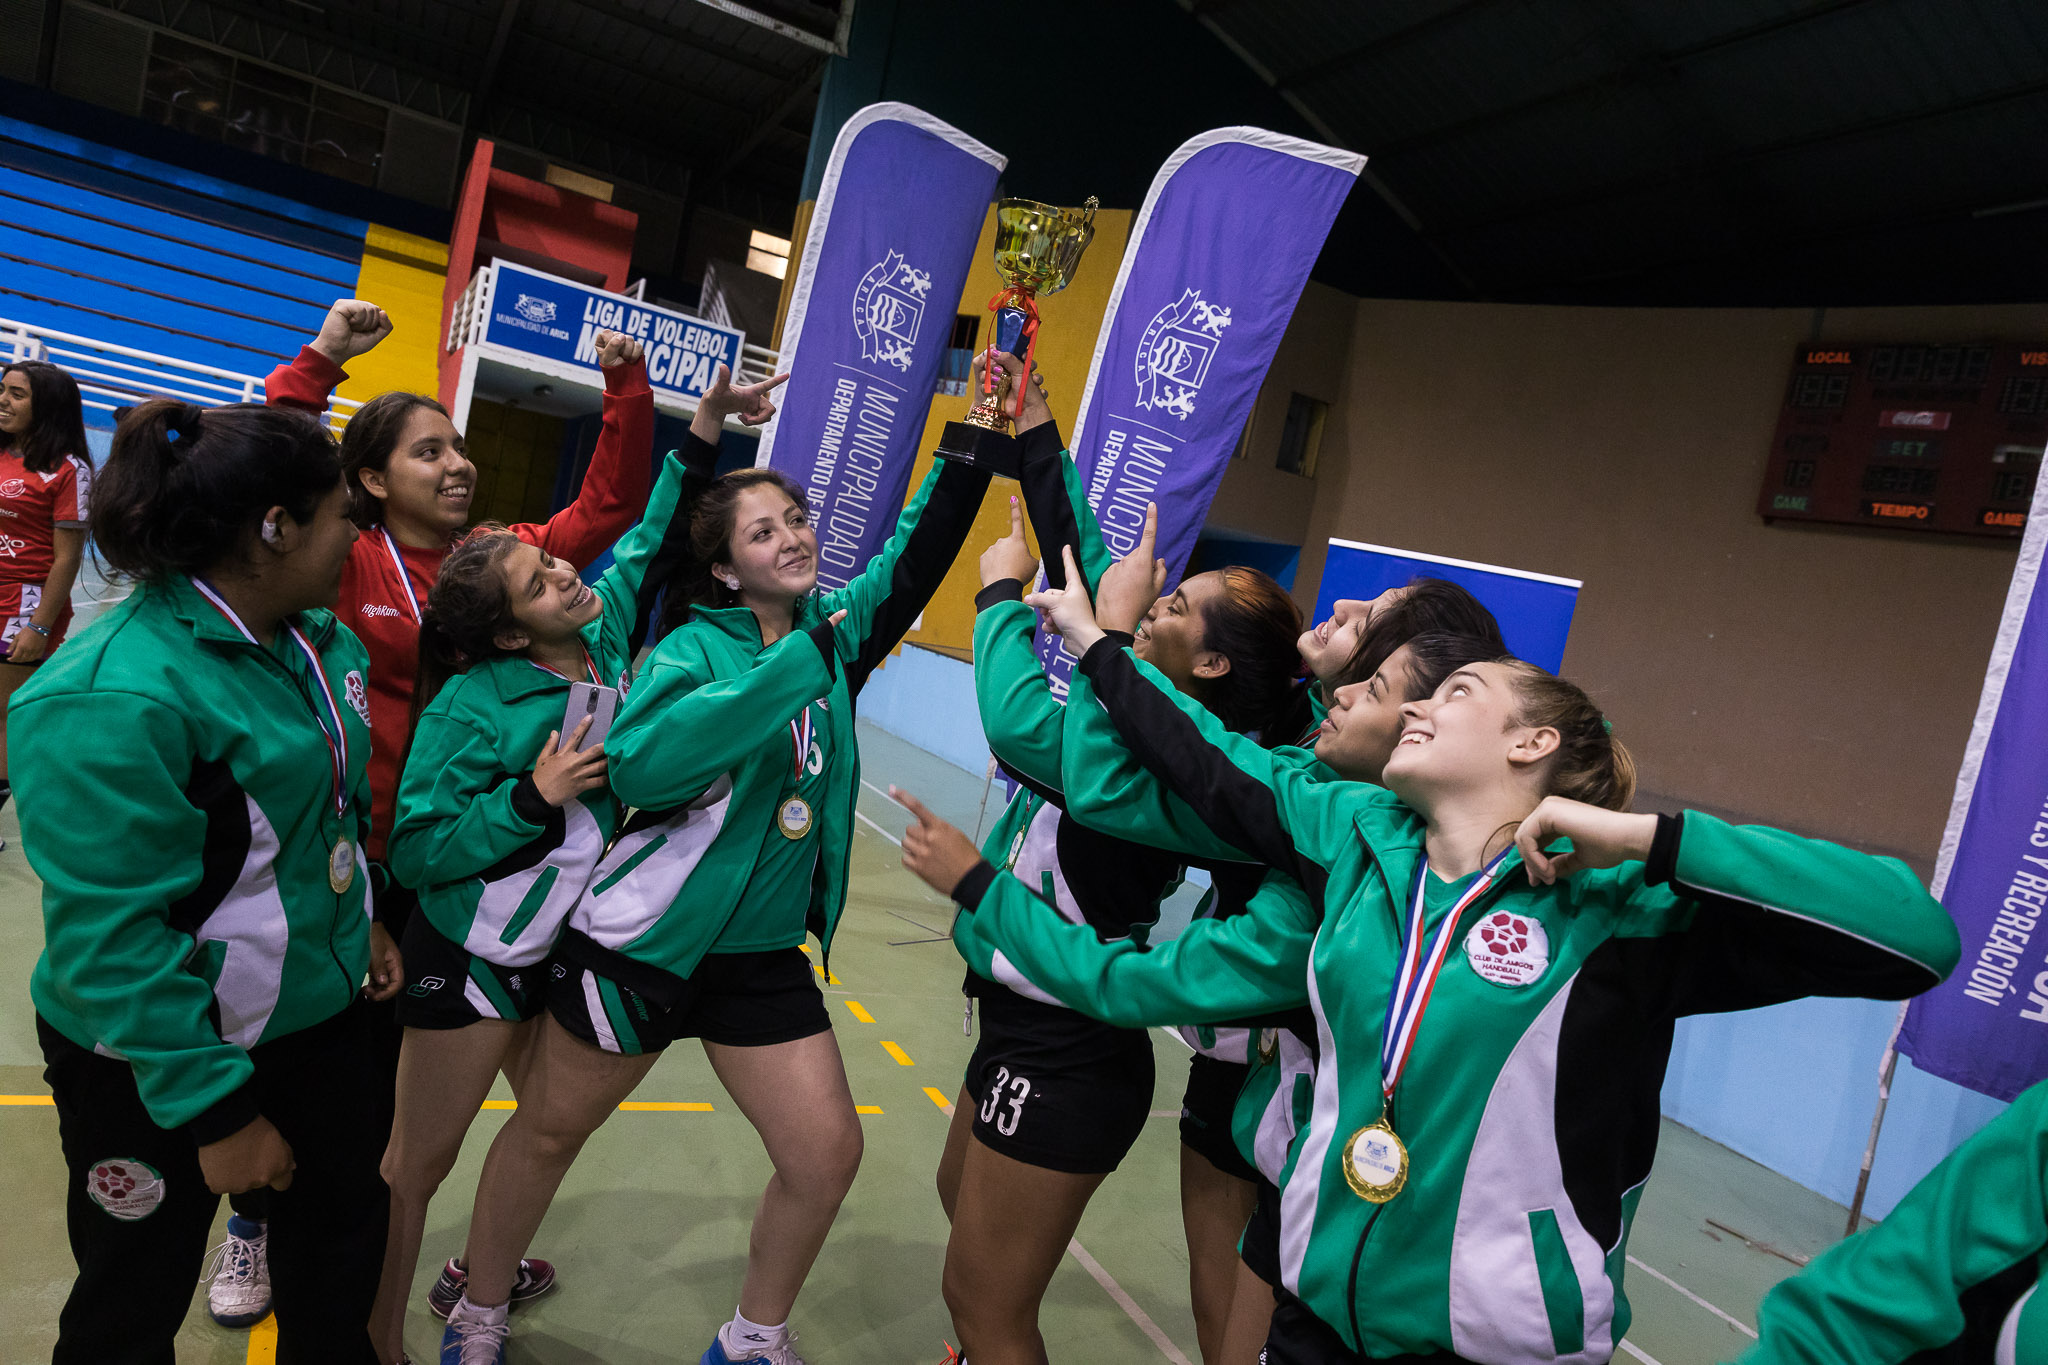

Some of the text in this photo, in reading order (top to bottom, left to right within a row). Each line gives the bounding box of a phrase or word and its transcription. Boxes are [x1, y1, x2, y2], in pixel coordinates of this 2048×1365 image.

[857, 275, 875, 325] ARICA
[496, 313, 569, 341] MUNICIPALIDAD DE ARICA
[583, 296, 728, 361] LIGA DE VOLEIBOL
[1138, 316, 1164, 372] ARICA
[1807, 352, 1852, 365] LOCAL
[810, 378, 857, 486] DEPARTAMENTO
[1890, 441, 1928, 457] SET
[821, 386, 899, 568] MUNICIPALIDAD
[1872, 502, 1928, 519] TIEMPO
[1984, 511, 2023, 527] GAME
[1963, 870, 2048, 1007] RECREACIÓN
[1474, 954, 1491, 962] CLUB
[1506, 959, 1534, 971] AMIGOS
[1482, 963, 1522, 976] HANDBALL
[981, 1066, 1031, 1136] 33
